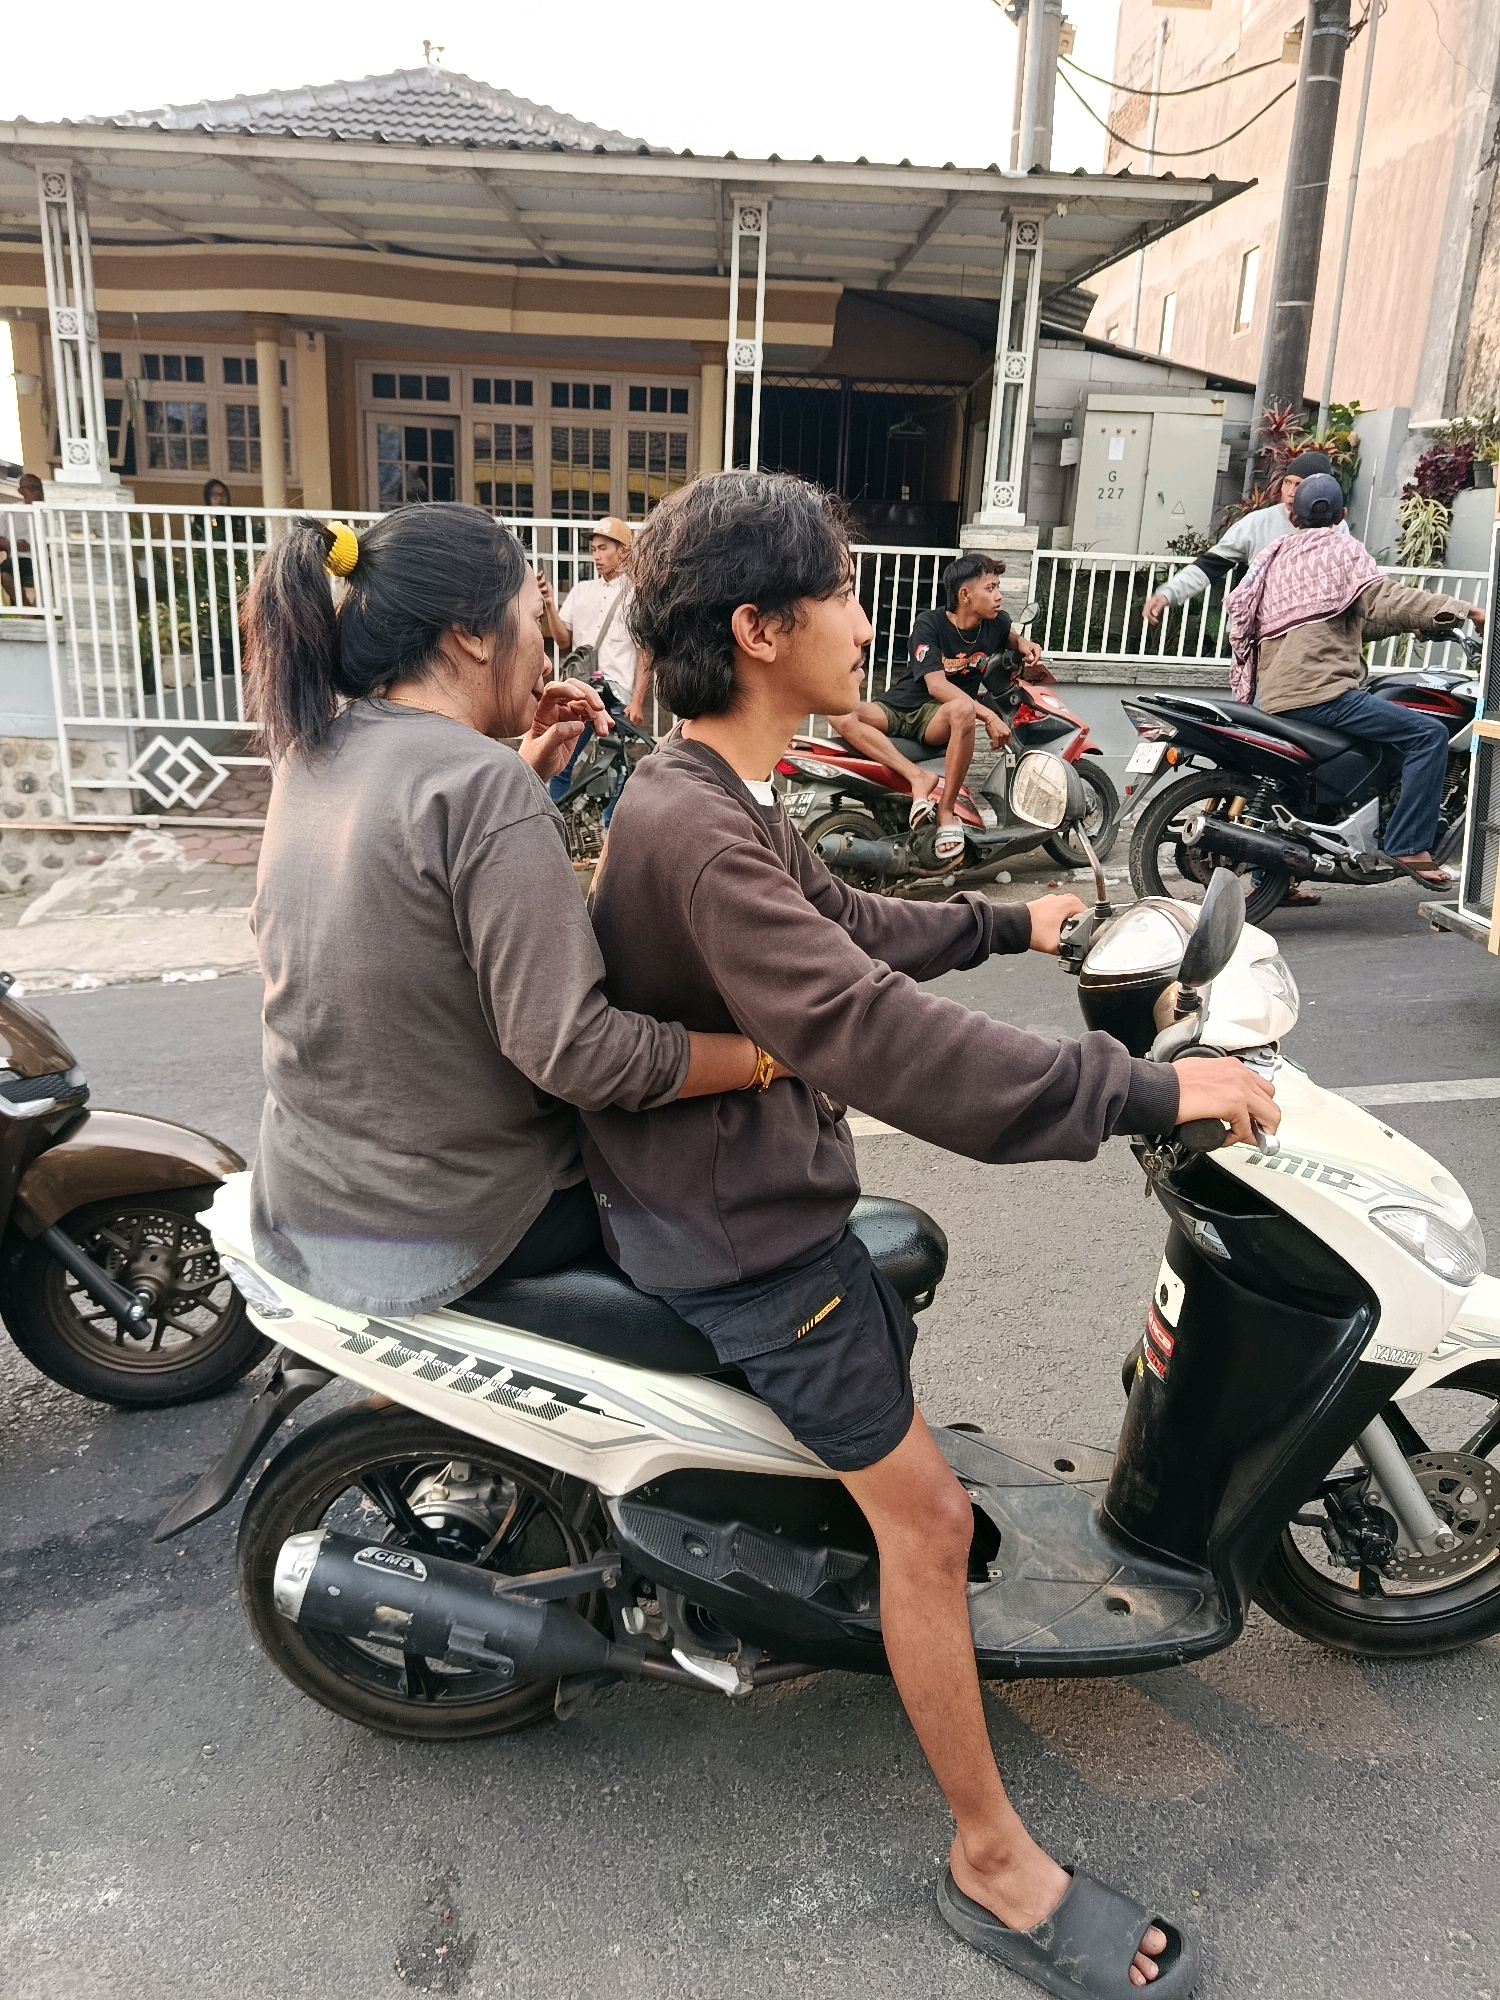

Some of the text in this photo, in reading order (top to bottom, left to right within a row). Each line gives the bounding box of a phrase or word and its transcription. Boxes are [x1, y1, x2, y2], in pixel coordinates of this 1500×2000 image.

[1108, 470, 1117, 482] G
[1098, 487, 1125, 500] 227
[1375, 1344, 1422, 1366] YAMAHA
[374, 1551, 413, 1568] CMS
